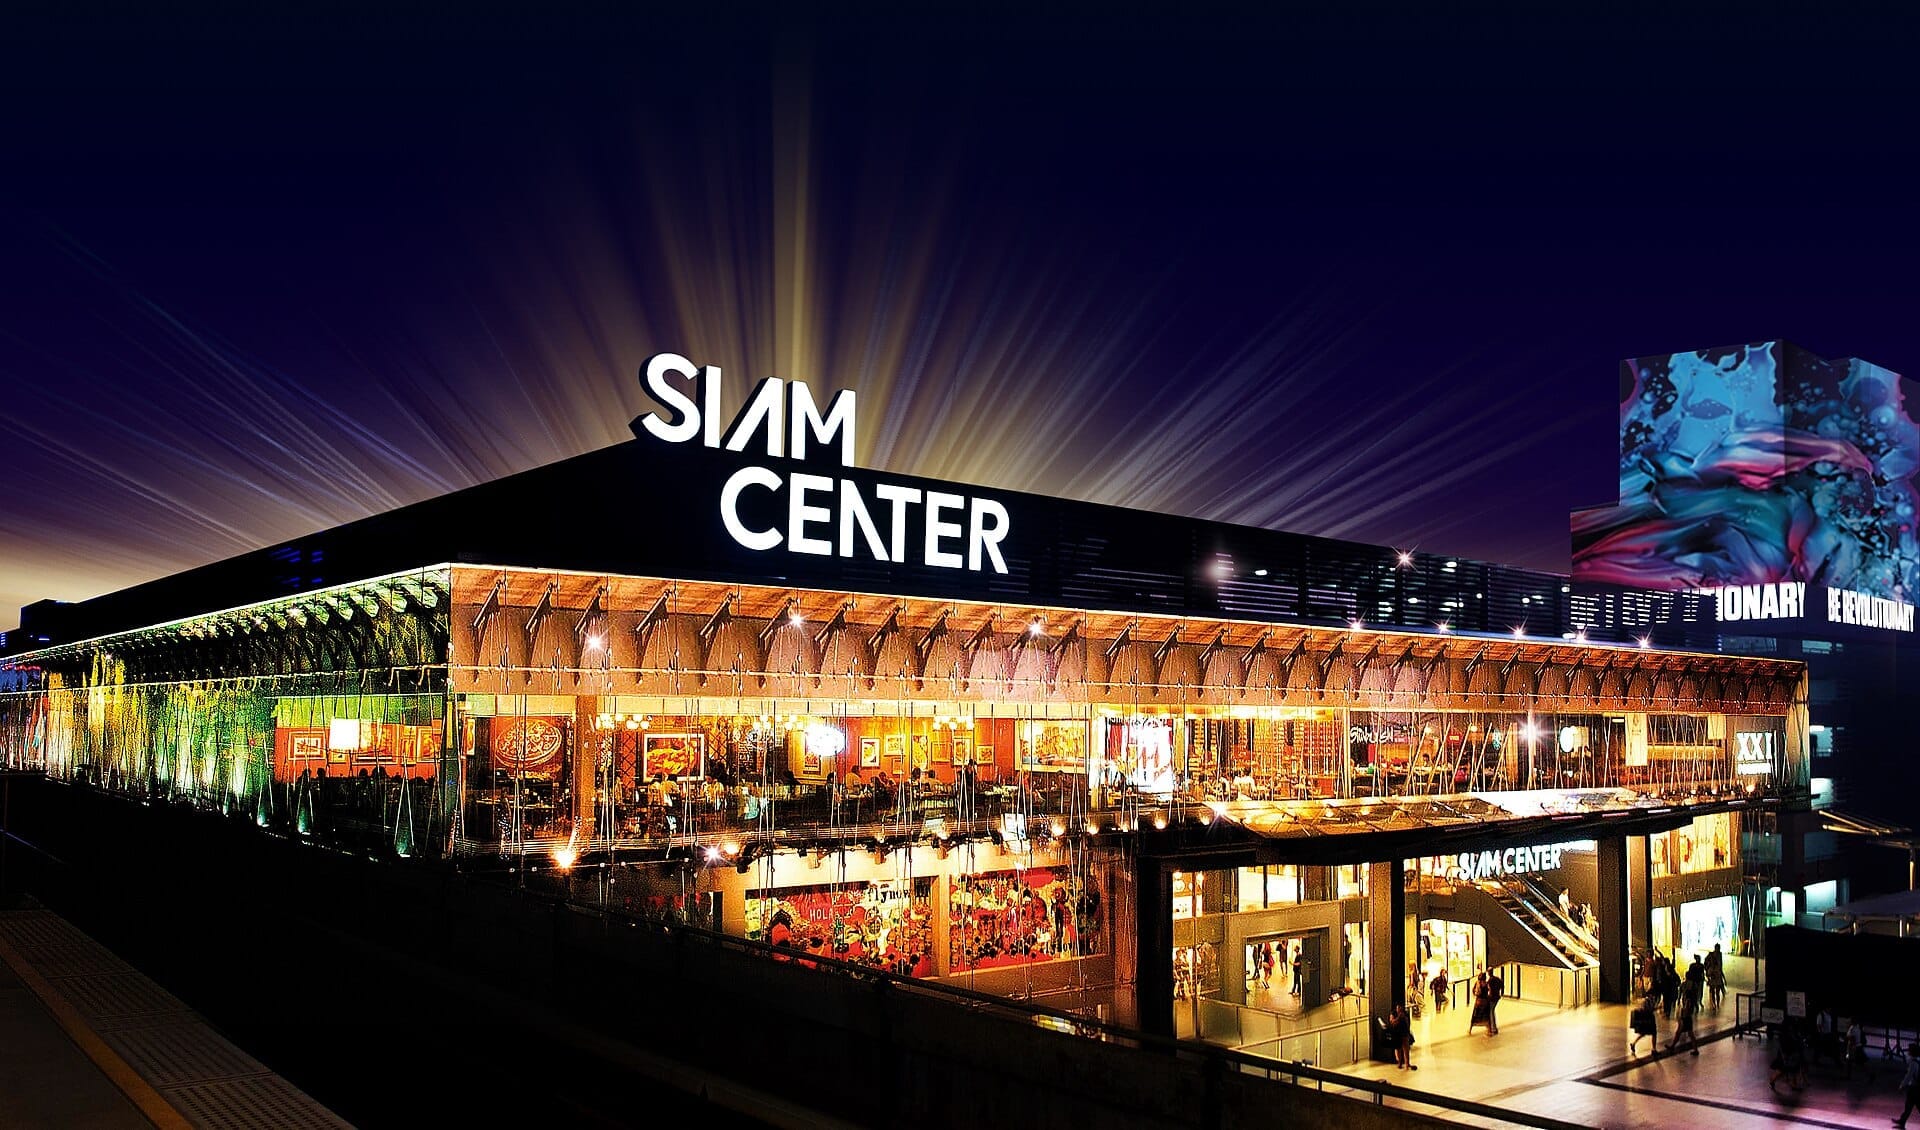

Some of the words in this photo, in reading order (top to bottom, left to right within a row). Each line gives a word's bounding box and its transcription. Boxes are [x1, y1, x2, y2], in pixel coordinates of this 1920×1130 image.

[639, 352, 857, 468] SIAM
[720, 466, 1011, 574] CENTER
[1827, 587, 1842, 622] BE
[1842, 589, 1915, 633] REVOLUTIONARY
[1736, 732, 1773, 761] XXI
[1459, 850, 1501, 880] SIAM
[1503, 844, 1562, 873] CENTER
